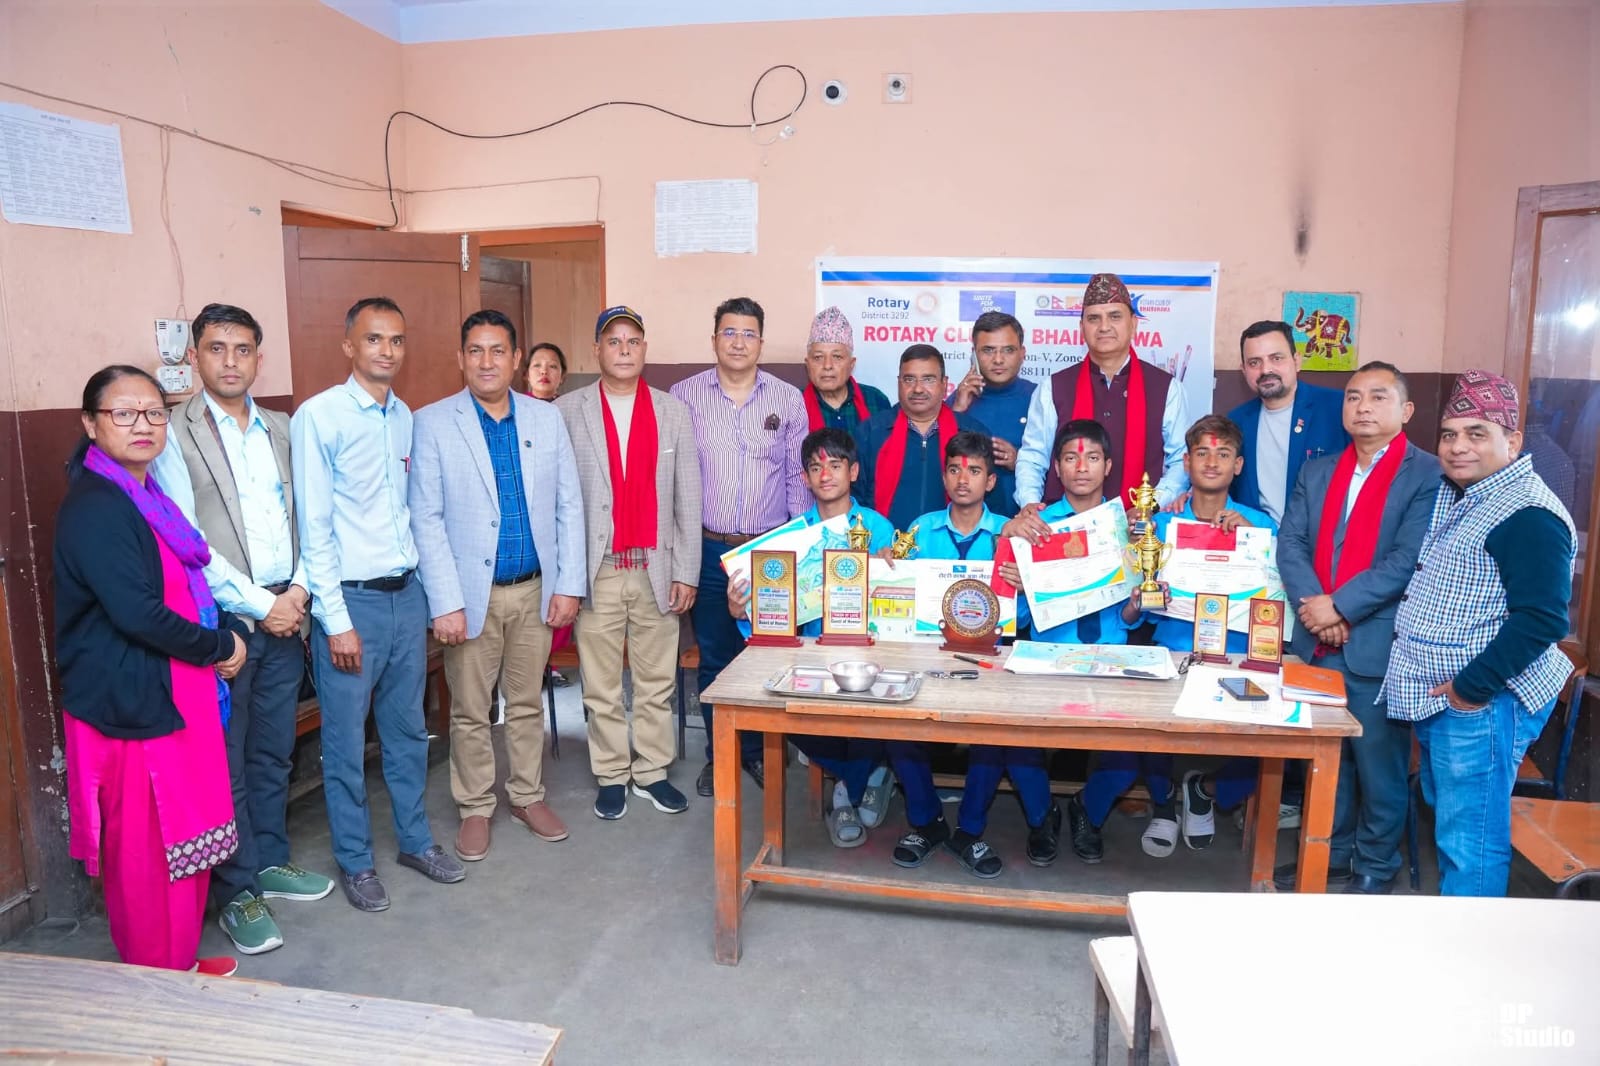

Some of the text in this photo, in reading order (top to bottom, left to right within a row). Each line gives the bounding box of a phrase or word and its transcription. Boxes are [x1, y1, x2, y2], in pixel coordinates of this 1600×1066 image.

[868, 297, 911, 310] Rotary
[861, 311, 909, 320] District 3292
[864, 326, 938, 342] ROTARY
